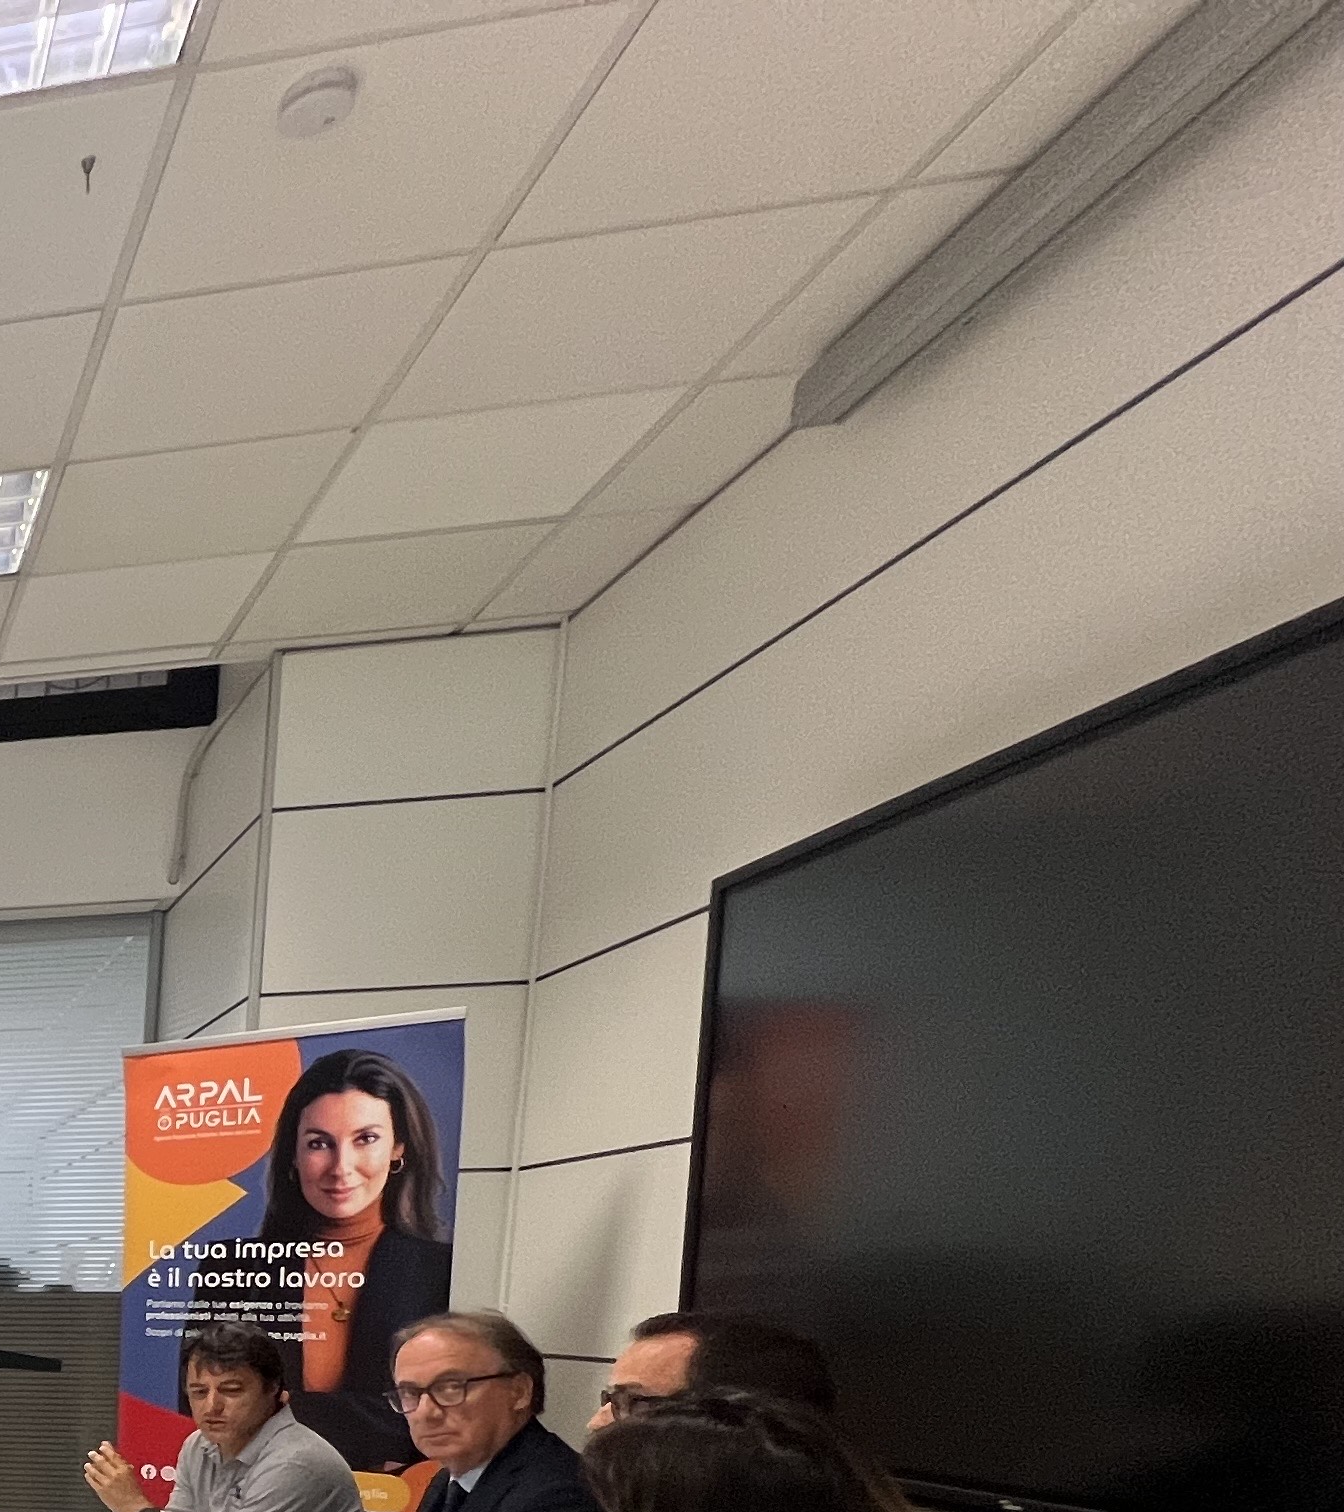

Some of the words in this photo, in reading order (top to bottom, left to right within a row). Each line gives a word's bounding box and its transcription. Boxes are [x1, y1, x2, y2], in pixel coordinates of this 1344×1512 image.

[154, 1077, 263, 1110] ARPAL
[175, 1107, 261, 1130] PUGLIA
[149, 1240, 174, 1260] La
[182, 1241, 227, 1260] tua
[235, 1238, 344, 1264] impresa
[147, 1268, 161, 1288] è
[167, 1267, 180, 1288] il
[188, 1268, 271, 1289] nostro
[279, 1266, 365, 1289] lavoro
